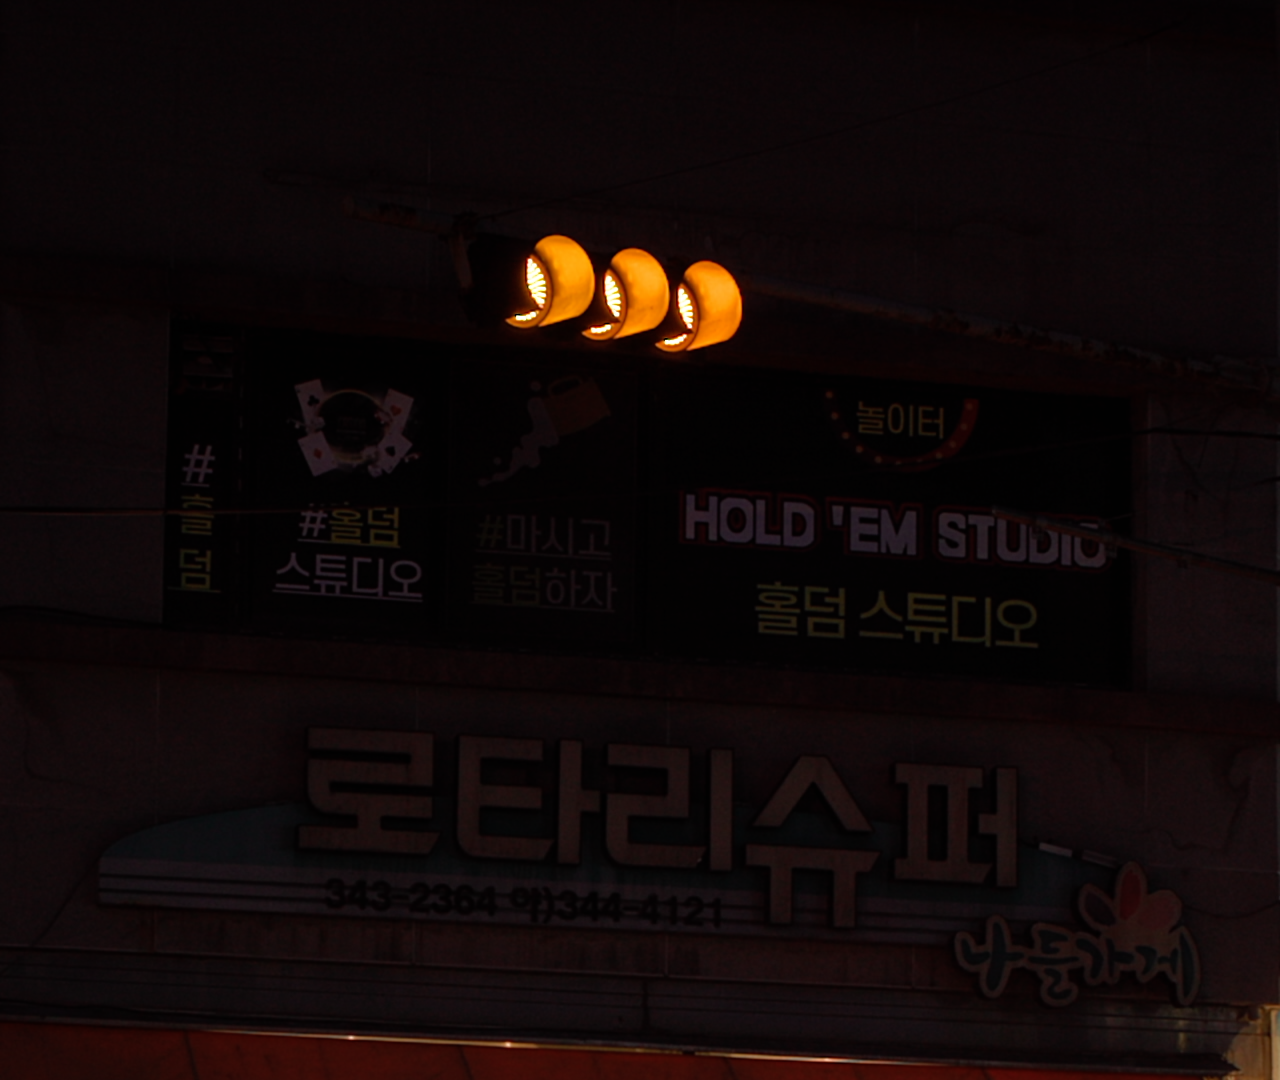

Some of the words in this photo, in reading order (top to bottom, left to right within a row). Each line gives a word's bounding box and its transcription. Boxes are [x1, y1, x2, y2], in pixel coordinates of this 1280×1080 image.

[855, 398, 947, 442] 놀이터
[475, 512, 614, 558] #마시고
[682, 490, 818, 552] HOLD
[934, 509, 1115, 571] STUDIO
[274, 551, 424, 600] 스튜디오
[471, 561, 619, 612] 홀덤하자
[755, 580, 849, 639] 홀덤
[859, 590, 1040, 651] 스튜디오
[297, 725, 1019, 931] 로타리슈퍼
[325, 877, 498, 917] 343-2364
[955, 914, 1201, 1006] 나들가게
